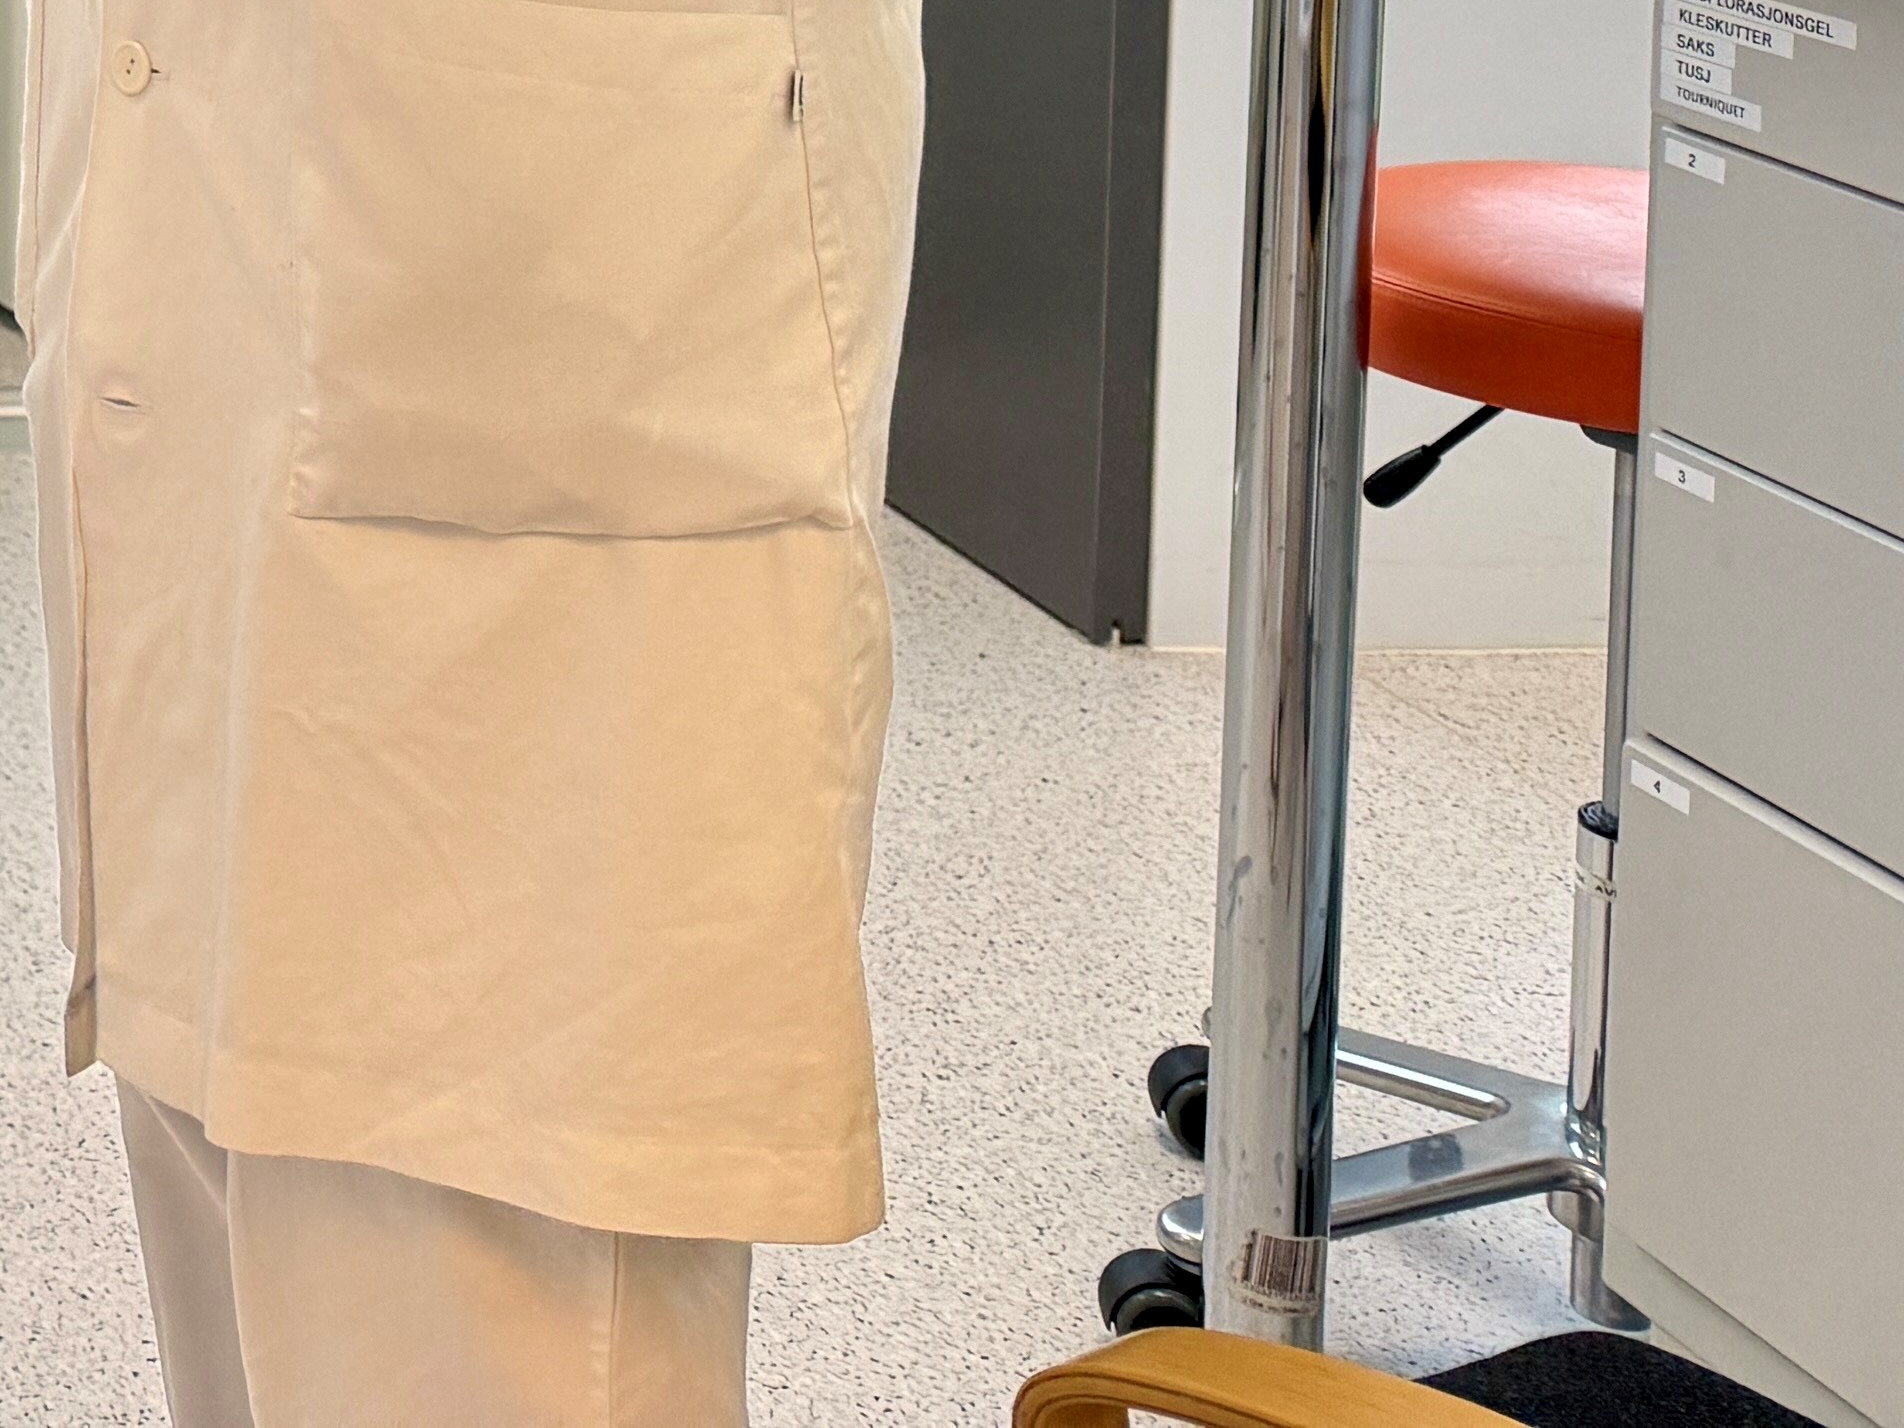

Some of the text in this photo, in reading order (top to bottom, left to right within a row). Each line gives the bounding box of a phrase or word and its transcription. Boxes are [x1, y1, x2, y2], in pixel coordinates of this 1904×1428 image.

[1679, 8, 1772, 49] KLESKUTTER
[1676, 33, 1715, 58] SAKS
[1676, 59, 1711, 84] TUSJ
[1676, 85, 1745, 119] TOURNIQUET
[1688, 153, 1696, 168] 2
[1678, 470, 1686, 484] 3
[1653, 779, 1661, 794] 4
